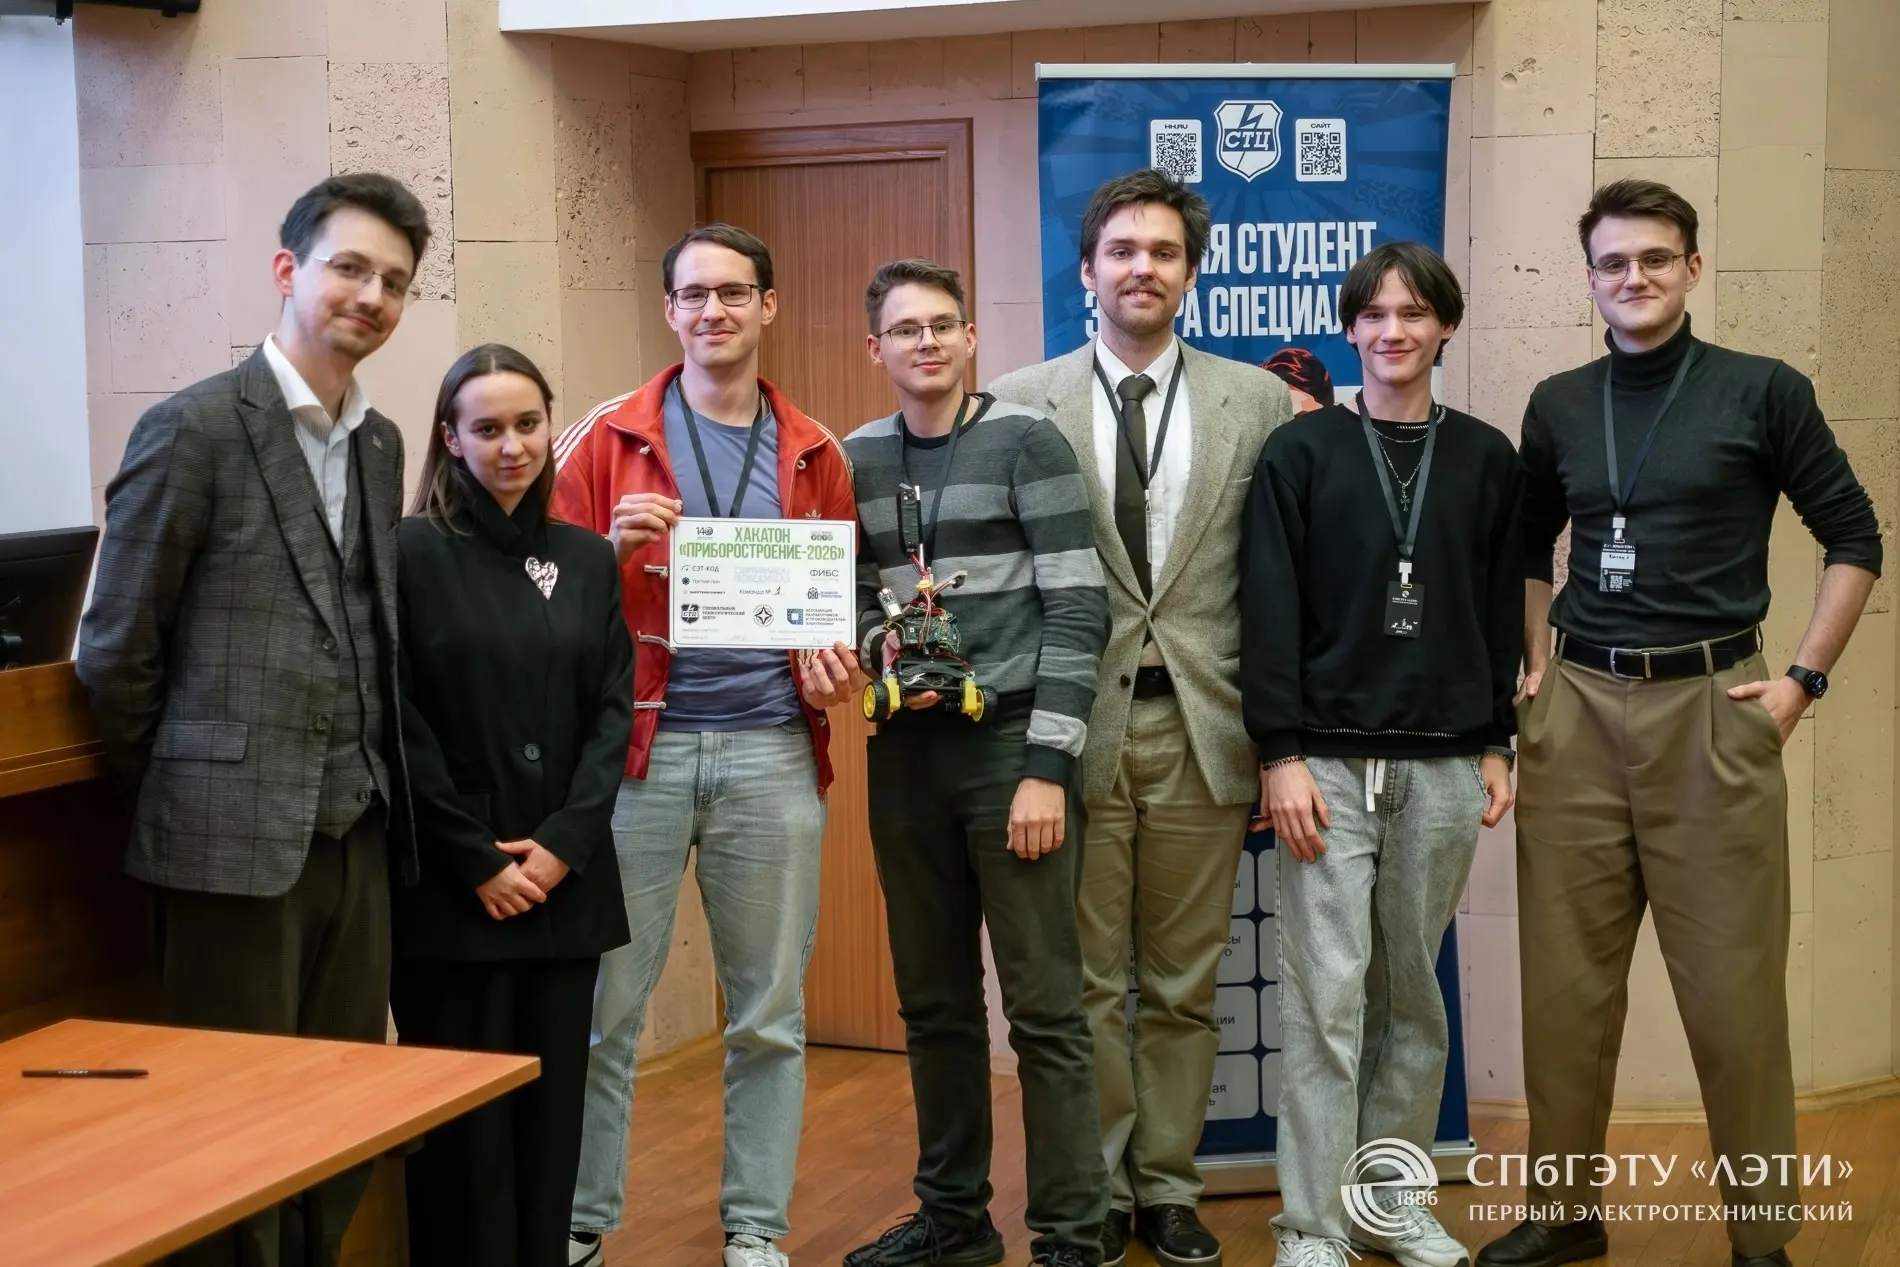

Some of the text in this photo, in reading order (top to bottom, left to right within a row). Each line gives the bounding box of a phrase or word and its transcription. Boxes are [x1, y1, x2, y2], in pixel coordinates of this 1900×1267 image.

[1224, 129, 1272, 151] СТЦ
[1237, 221, 1377, 280] СТУДЕНТ
[734, 526, 791, 544] ХАКАТОН
[679, 542, 845, 561] «ПРИБОРОСТРОЕНИЕ-2026»
[809, 569, 839, 577] ФИБС
